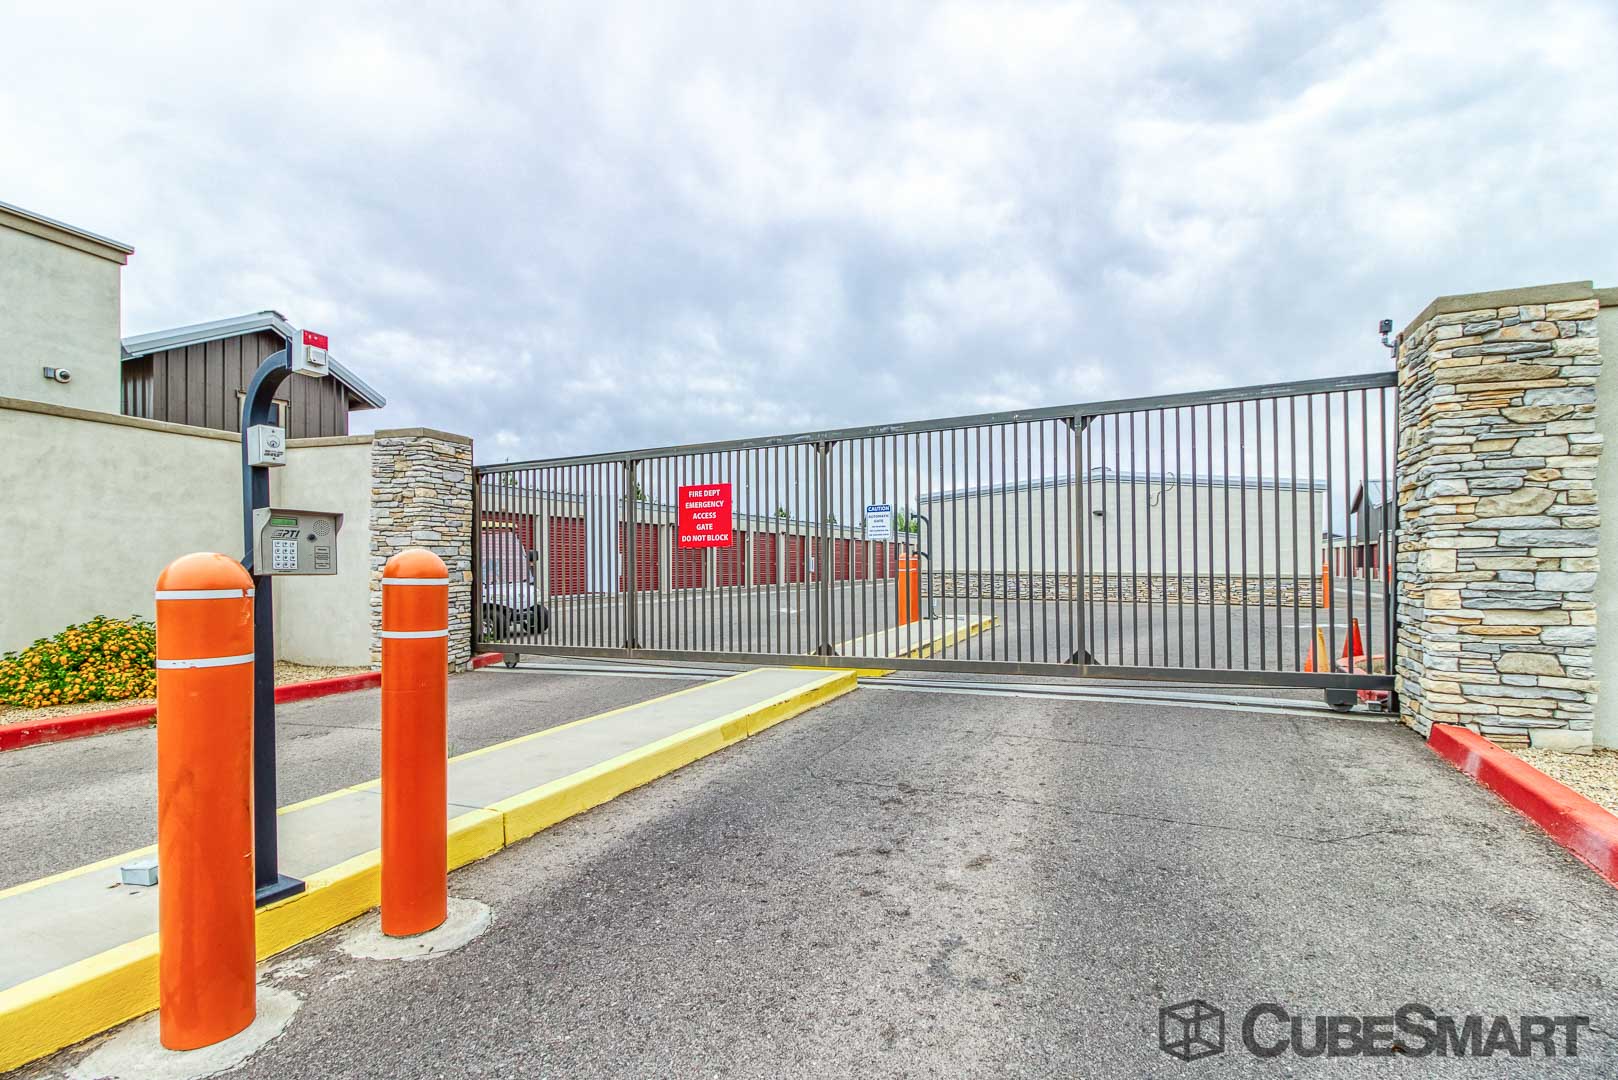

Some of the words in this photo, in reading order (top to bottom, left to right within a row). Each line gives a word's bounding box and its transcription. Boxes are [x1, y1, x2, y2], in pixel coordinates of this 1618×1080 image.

[688, 490, 703, 498] FIRE
[703, 489, 720, 497] DEPT
[685, 500, 724, 509] EMERGENCY
[282, 529, 300, 538] PTI
[692, 534, 706, 542] NOT
[707, 533, 729, 541] BLOCK
